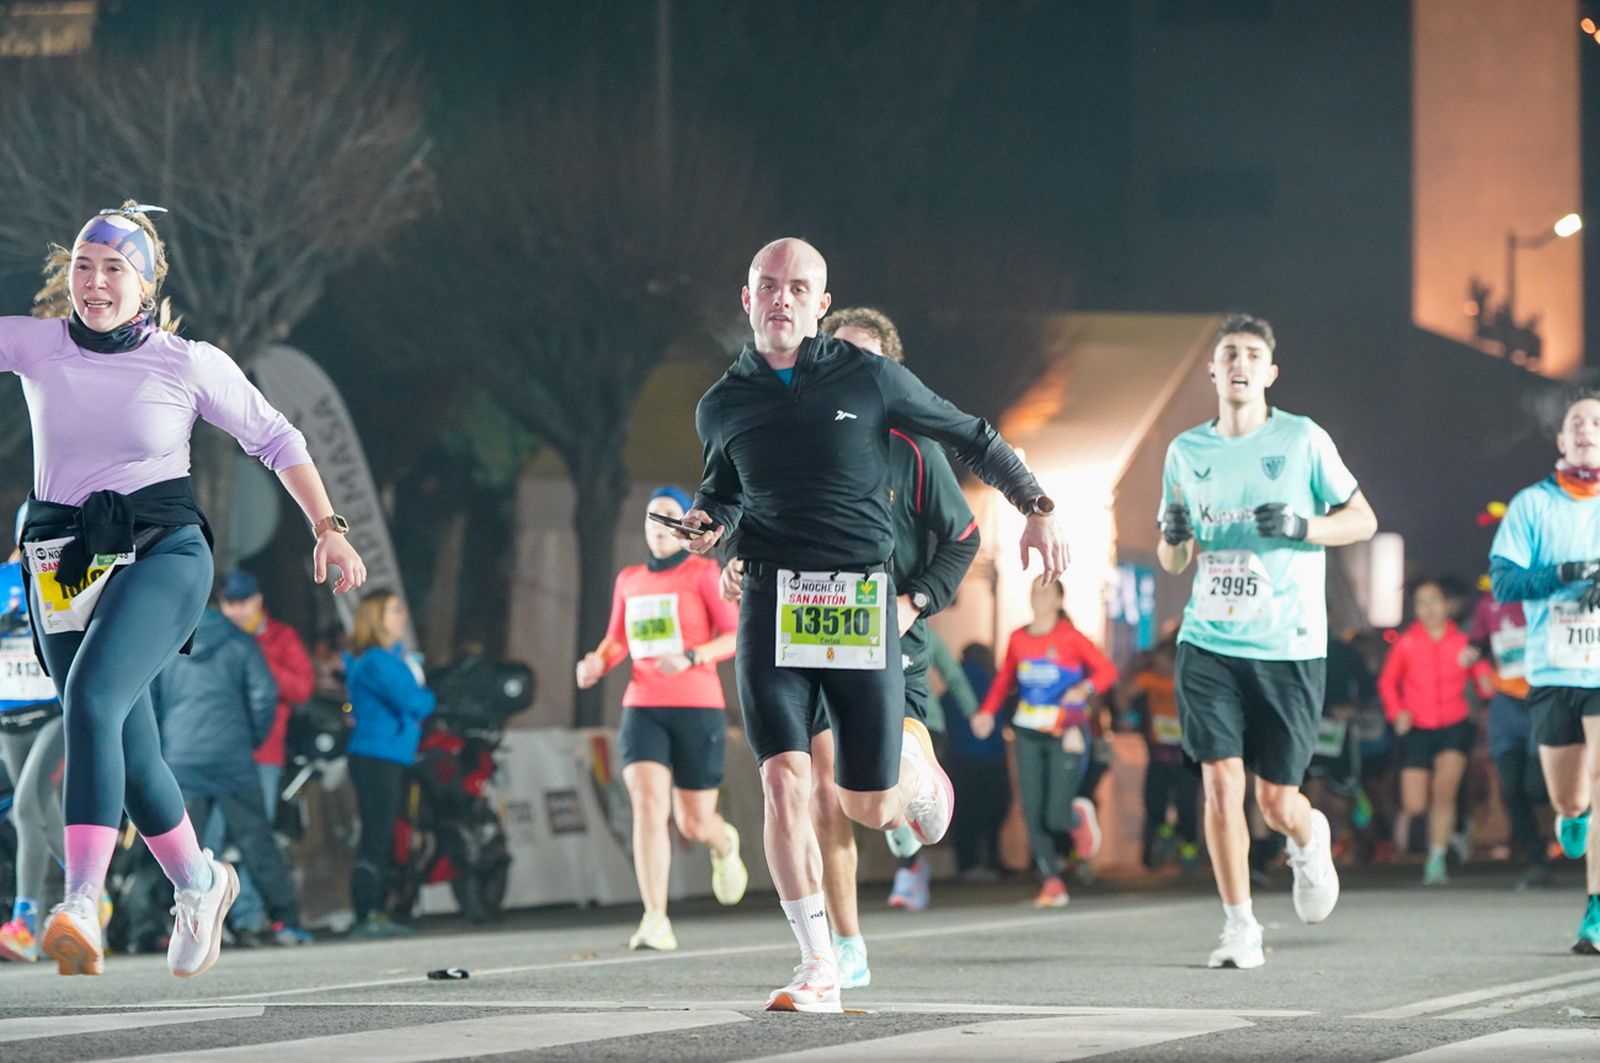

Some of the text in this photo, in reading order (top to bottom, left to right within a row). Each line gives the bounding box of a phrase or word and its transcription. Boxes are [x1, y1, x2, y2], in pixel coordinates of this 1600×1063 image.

[1199, 503, 1253, 523] Kutxab
[802, 582, 832, 592] NOCHE
[834, 583, 847, 592] DE
[1209, 575, 1258, 597] 2995
[789, 593, 809, 604] SAN
[811, 593, 847, 605] ANTÓN
[791, 606, 870, 636] 13510
[1566, 627, 1600, 645] 710
